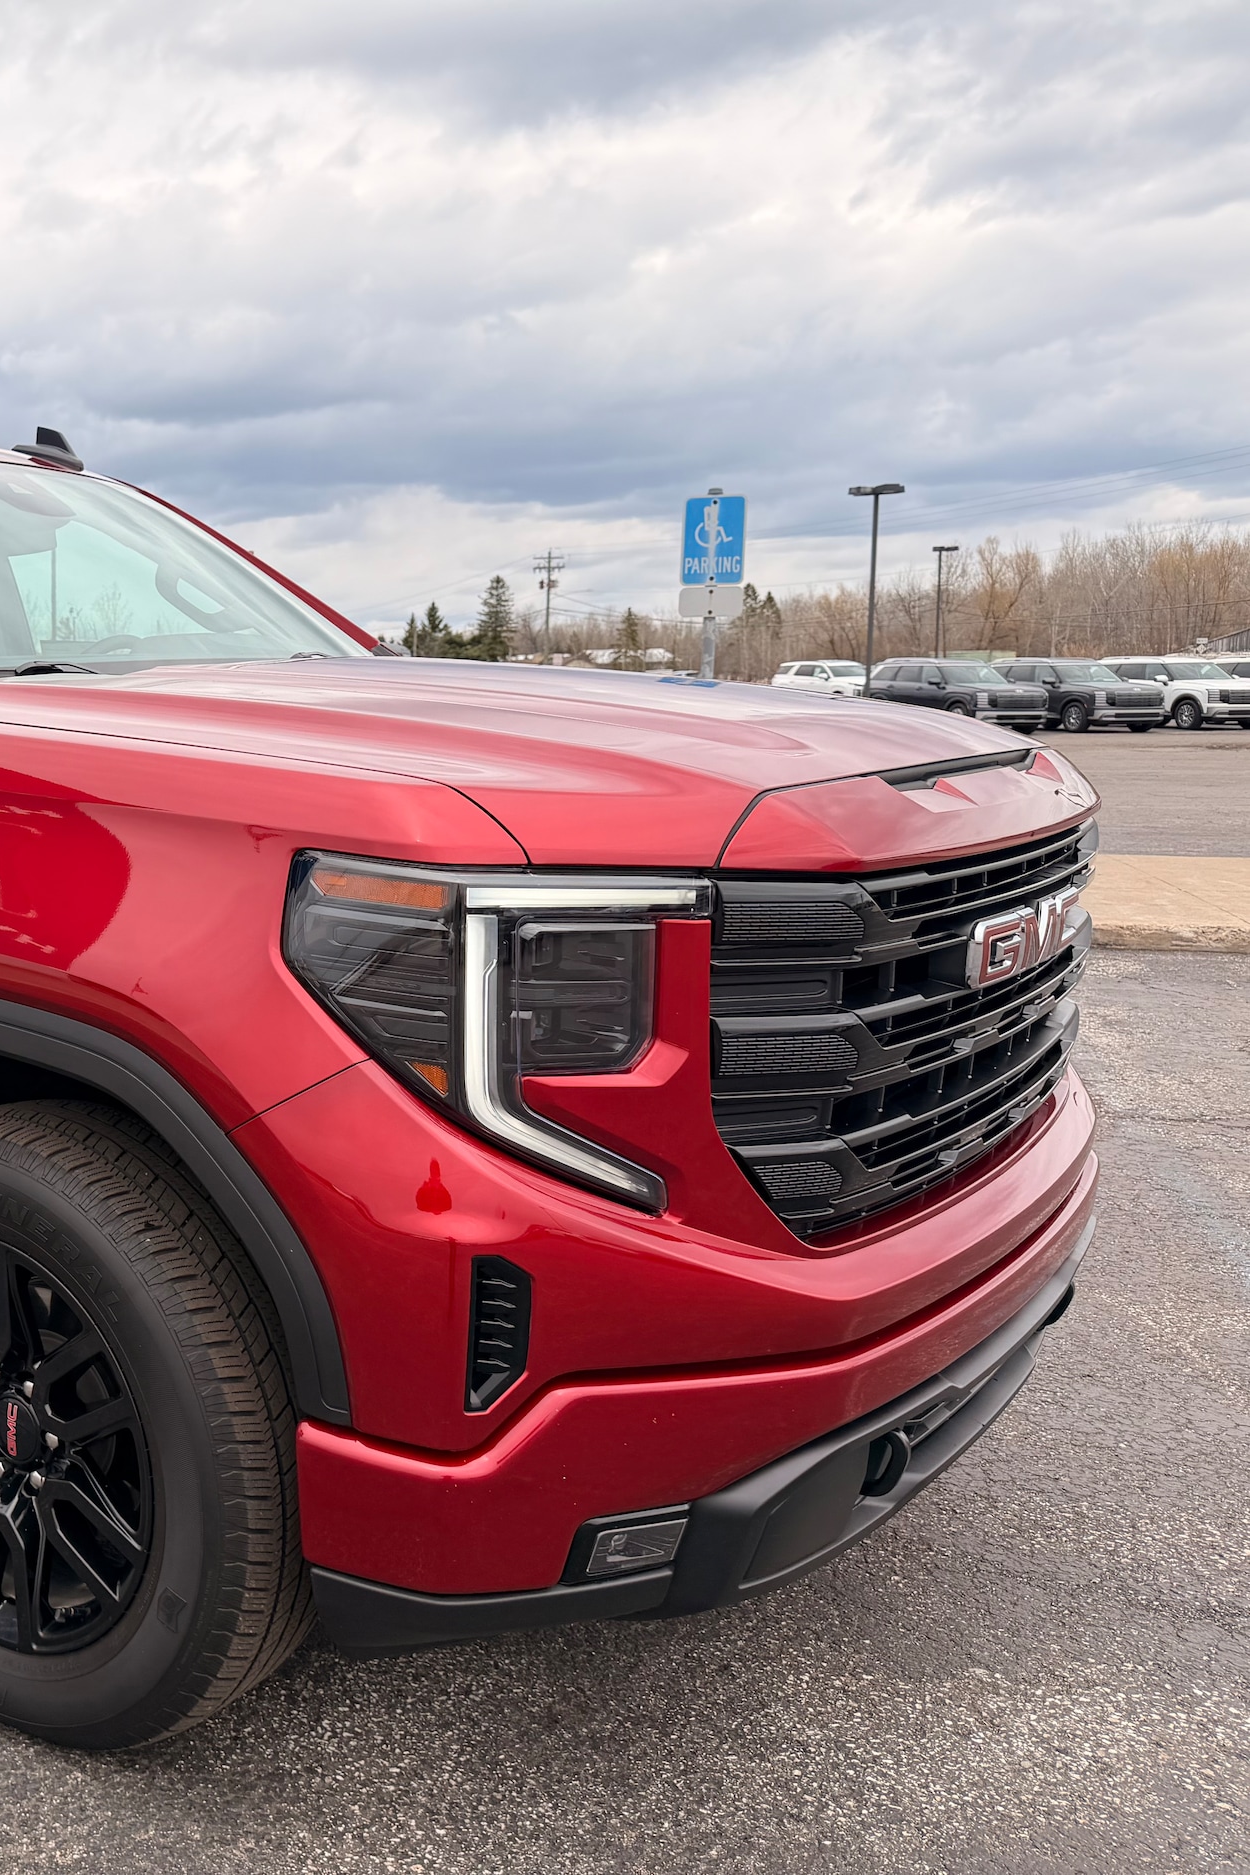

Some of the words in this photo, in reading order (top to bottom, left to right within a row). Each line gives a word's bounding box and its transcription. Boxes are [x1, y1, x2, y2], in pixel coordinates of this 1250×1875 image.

[684, 556, 741, 574] PARKING
[968, 886, 1080, 988] GMC
[7, 1402, 18, 1457] GMC
